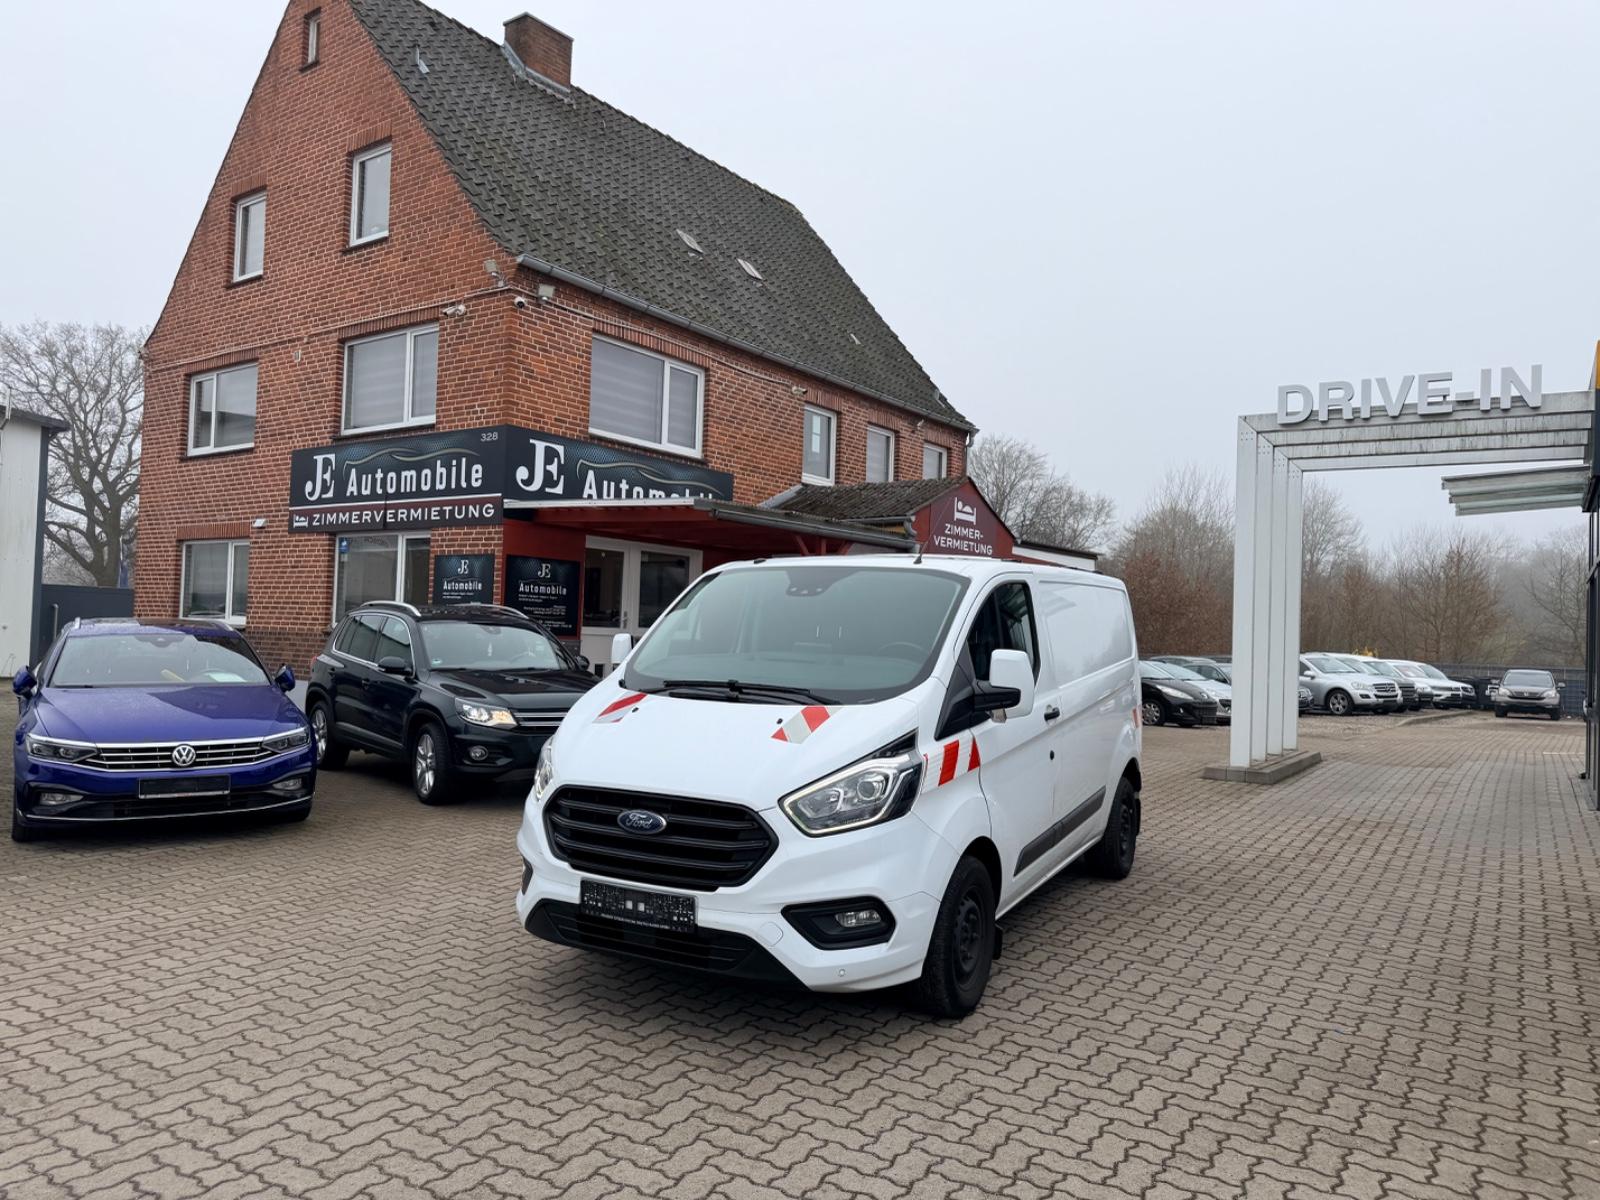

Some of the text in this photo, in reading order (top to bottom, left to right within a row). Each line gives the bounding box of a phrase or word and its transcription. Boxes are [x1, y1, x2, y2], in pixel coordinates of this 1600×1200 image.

[1276, 364, 1543, 426] DRIVE-IN
[480, 431, 499, 442] 328
[346, 457, 483, 497] Automobile
[312, 503, 495, 526] ZIMMERVERMIETUNG
[944, 523, 984, 541] ZIMMER-
[933, 534, 993, 555] VERMIETUNG
[443, 580, 483, 591] Automobile
[518, 582, 568, 596] Automobile
[625, 811, 654, 830] Ford
